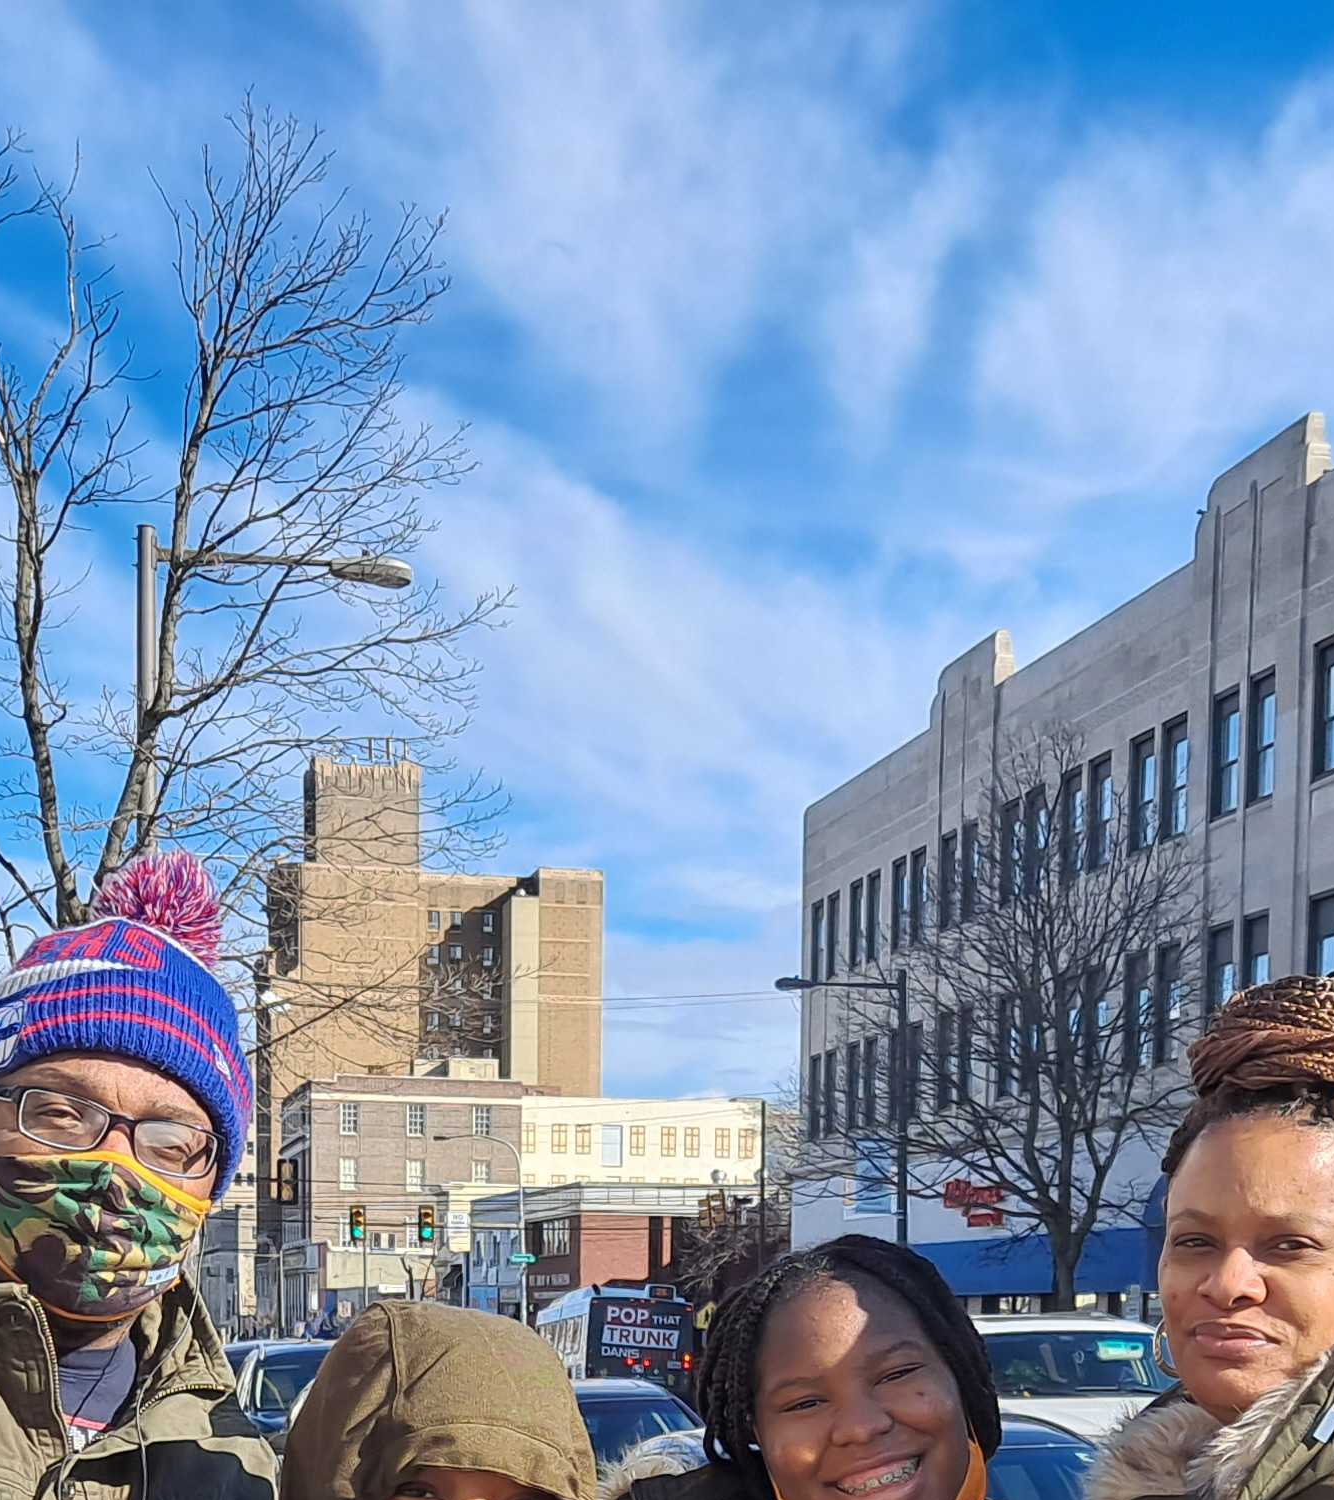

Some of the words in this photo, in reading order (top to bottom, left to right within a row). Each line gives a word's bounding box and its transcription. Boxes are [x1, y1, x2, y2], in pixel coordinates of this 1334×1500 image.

[607, 1305, 649, 1325] POP
[652, 1315, 681, 1326] THAT
[608, 1327, 675, 1347] TRUNK
